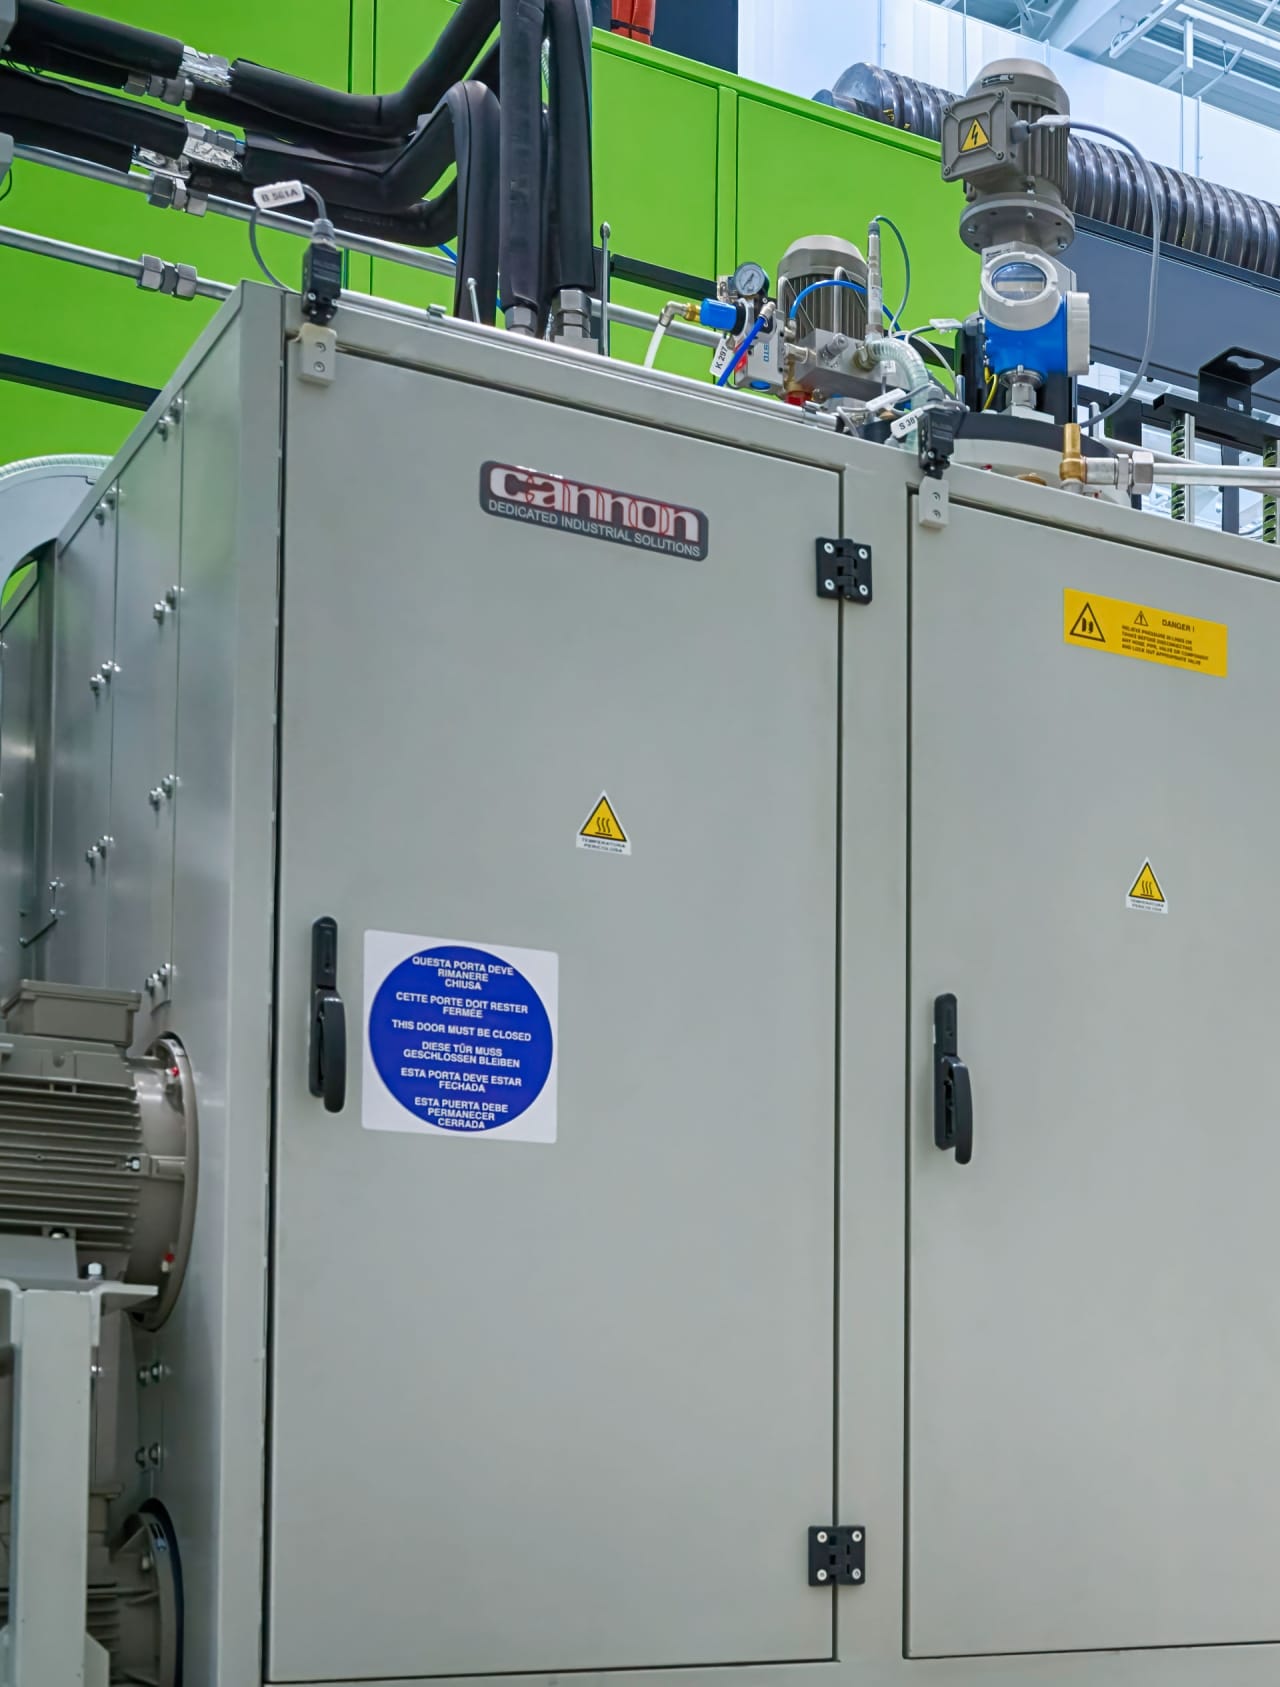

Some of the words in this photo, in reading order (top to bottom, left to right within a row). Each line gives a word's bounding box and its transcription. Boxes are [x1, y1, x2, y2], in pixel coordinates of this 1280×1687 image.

[715, 361, 723, 370] K
[719, 346, 728, 362] 297
[489, 466, 699, 543] cannon
[488, 499, 558, 525] DEDICATED
[561, 515, 632, 542] INDUSTRIAL
[634, 532, 700, 558] SOLUTIONS
[1161, 619, 1191, 632] DANGER
[412, 956, 451, 968] QUESTA
[453, 961, 486, 972] PORTA
[488, 965, 514, 976] DEVE
[437, 968, 488, 982] RIMANERE
[445, 978, 482, 990] CHIUSA
[396, 991, 428, 1003] CETTE
[430, 995, 463, 1007] PORTE
[465, 999, 488, 1009] DOIT
[490, 1002, 528, 1014] RESTER
[392, 1019, 414, 1030] THIS
[416, 1022, 445, 1033] DOOR
[448, 1025, 475, 1036] MUST
[477, 1028, 490, 1037] BE
[492, 1030, 532, 1042] CLOSED
[422, 1041, 450, 1052] DIESE
[453, 1042, 473, 1054] TÜR
[475, 1046, 502, 1057] MUSS
[403, 1049, 476, 1065] GESCHLOSSEN
[479, 1056, 520, 1068] BLEIBEN
[401, 1067, 426, 1078] ESTA
[428, 1070, 461, 1082] PORTA
[463, 1073, 489, 1083] DEVE
[490, 1075, 522, 1087] ESTAR
[438, 1080, 486, 1093] FECHADA
[414, 1097, 440, 1107] ESTA
[442, 1099, 480, 1111] PUERTA
[482, 1102, 508, 1113] DEBE
[428, 1107, 495, 1121] PERMANECER
[437, 1117, 485, 1129] CERRADA
